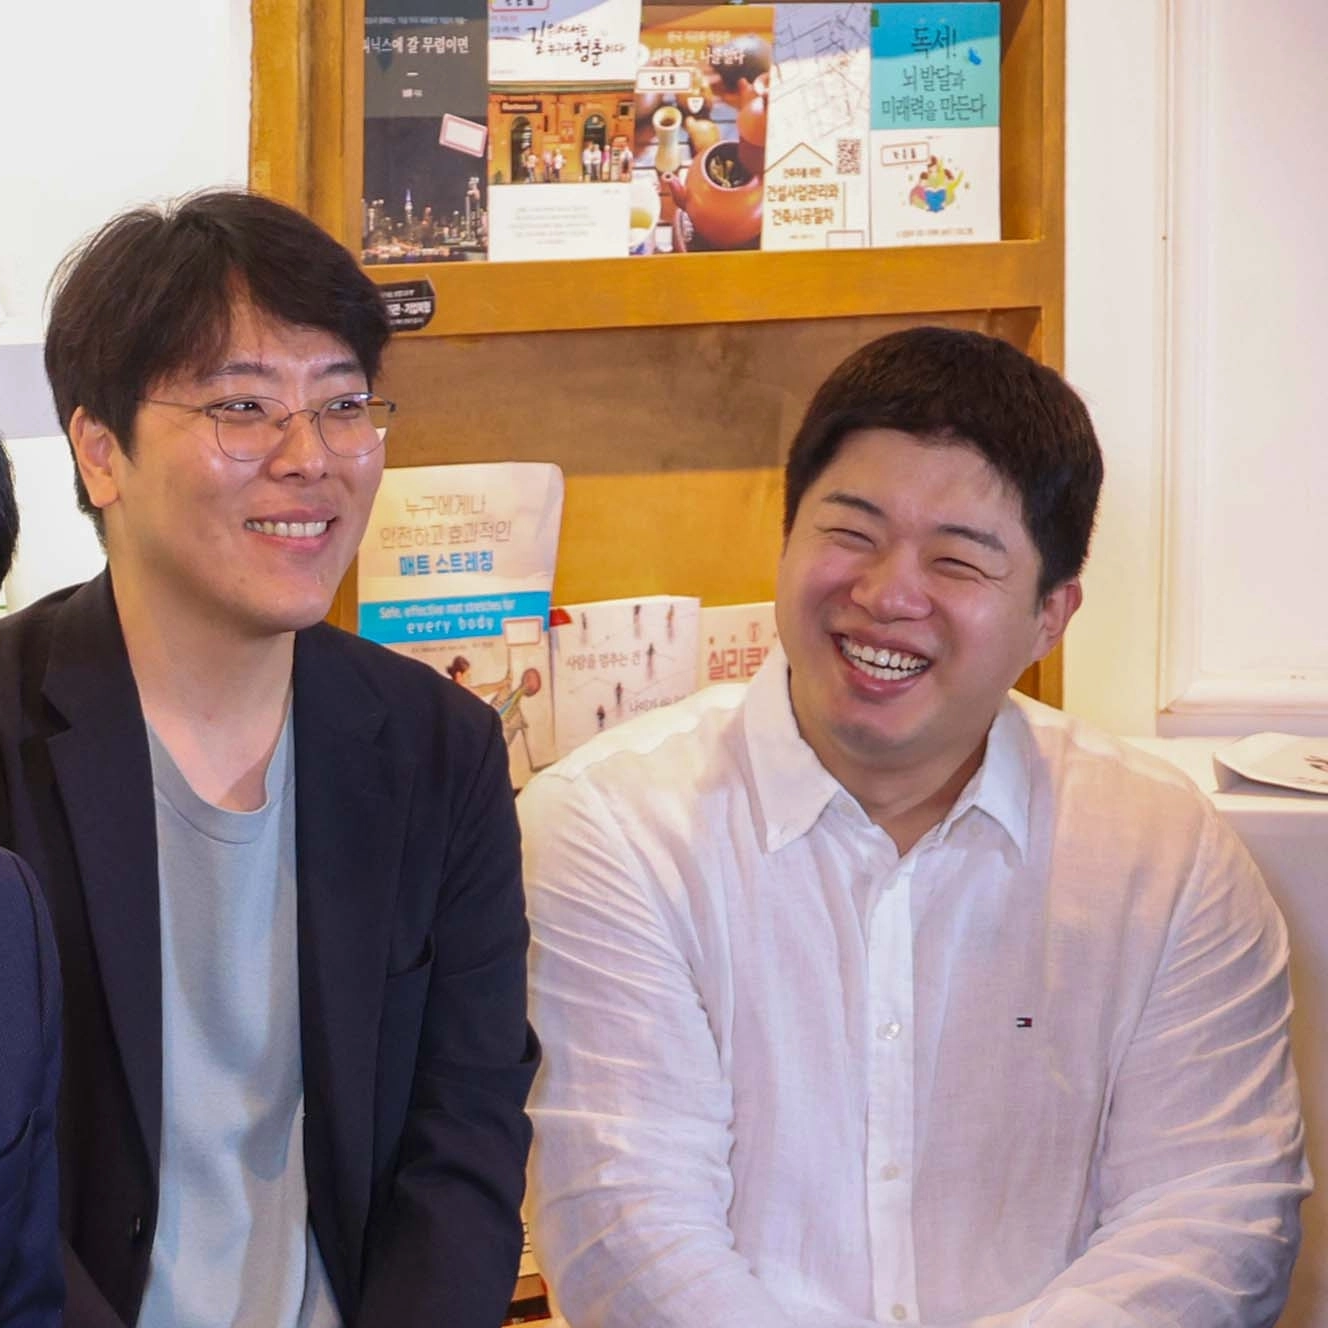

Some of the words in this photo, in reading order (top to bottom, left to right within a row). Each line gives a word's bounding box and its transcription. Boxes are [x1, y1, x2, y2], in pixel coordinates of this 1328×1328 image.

[423, 35, 469, 55] 무렵이면
[903, 66, 918, 92] 뇌
[921, 64, 966, 92] 발달과
[881, 95, 937, 122] 미래력을
[940, 94, 986, 121] 만든다
[404, 495, 486, 517] 누구에게나
[380, 525, 444, 550] 안전하고
[448, 520, 512, 545] 효과적인
[399, 554, 431, 576] 매트
[436, 551, 493, 575] 스트레칭
[406, 620, 452, 634] every
[458, 615, 495, 630] body
